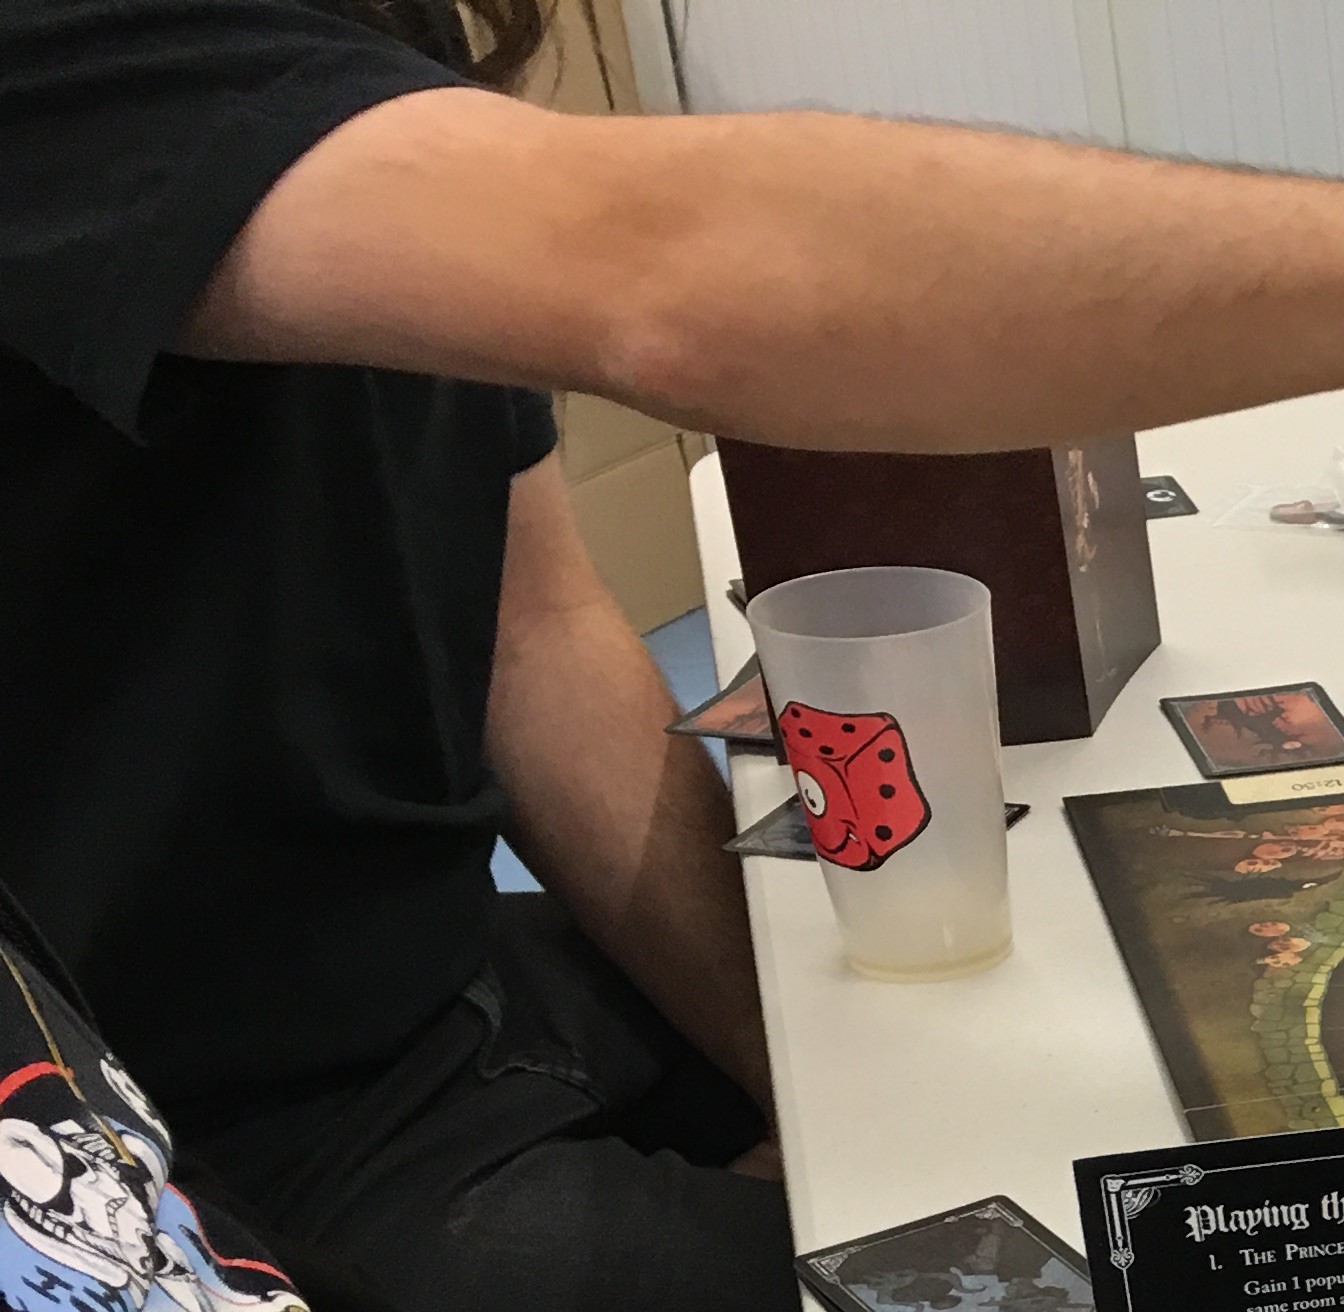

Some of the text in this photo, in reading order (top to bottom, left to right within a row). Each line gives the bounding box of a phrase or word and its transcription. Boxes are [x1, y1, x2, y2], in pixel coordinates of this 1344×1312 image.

[1184, 1199, 1309, 1242] Playing
[1238, 1247, 1276, 1266] THE
[1243, 1278, 1287, 1296] Gain
[1290, 1275, 1301, 1290] 1
[1291, 1295, 1336, 1311] room
